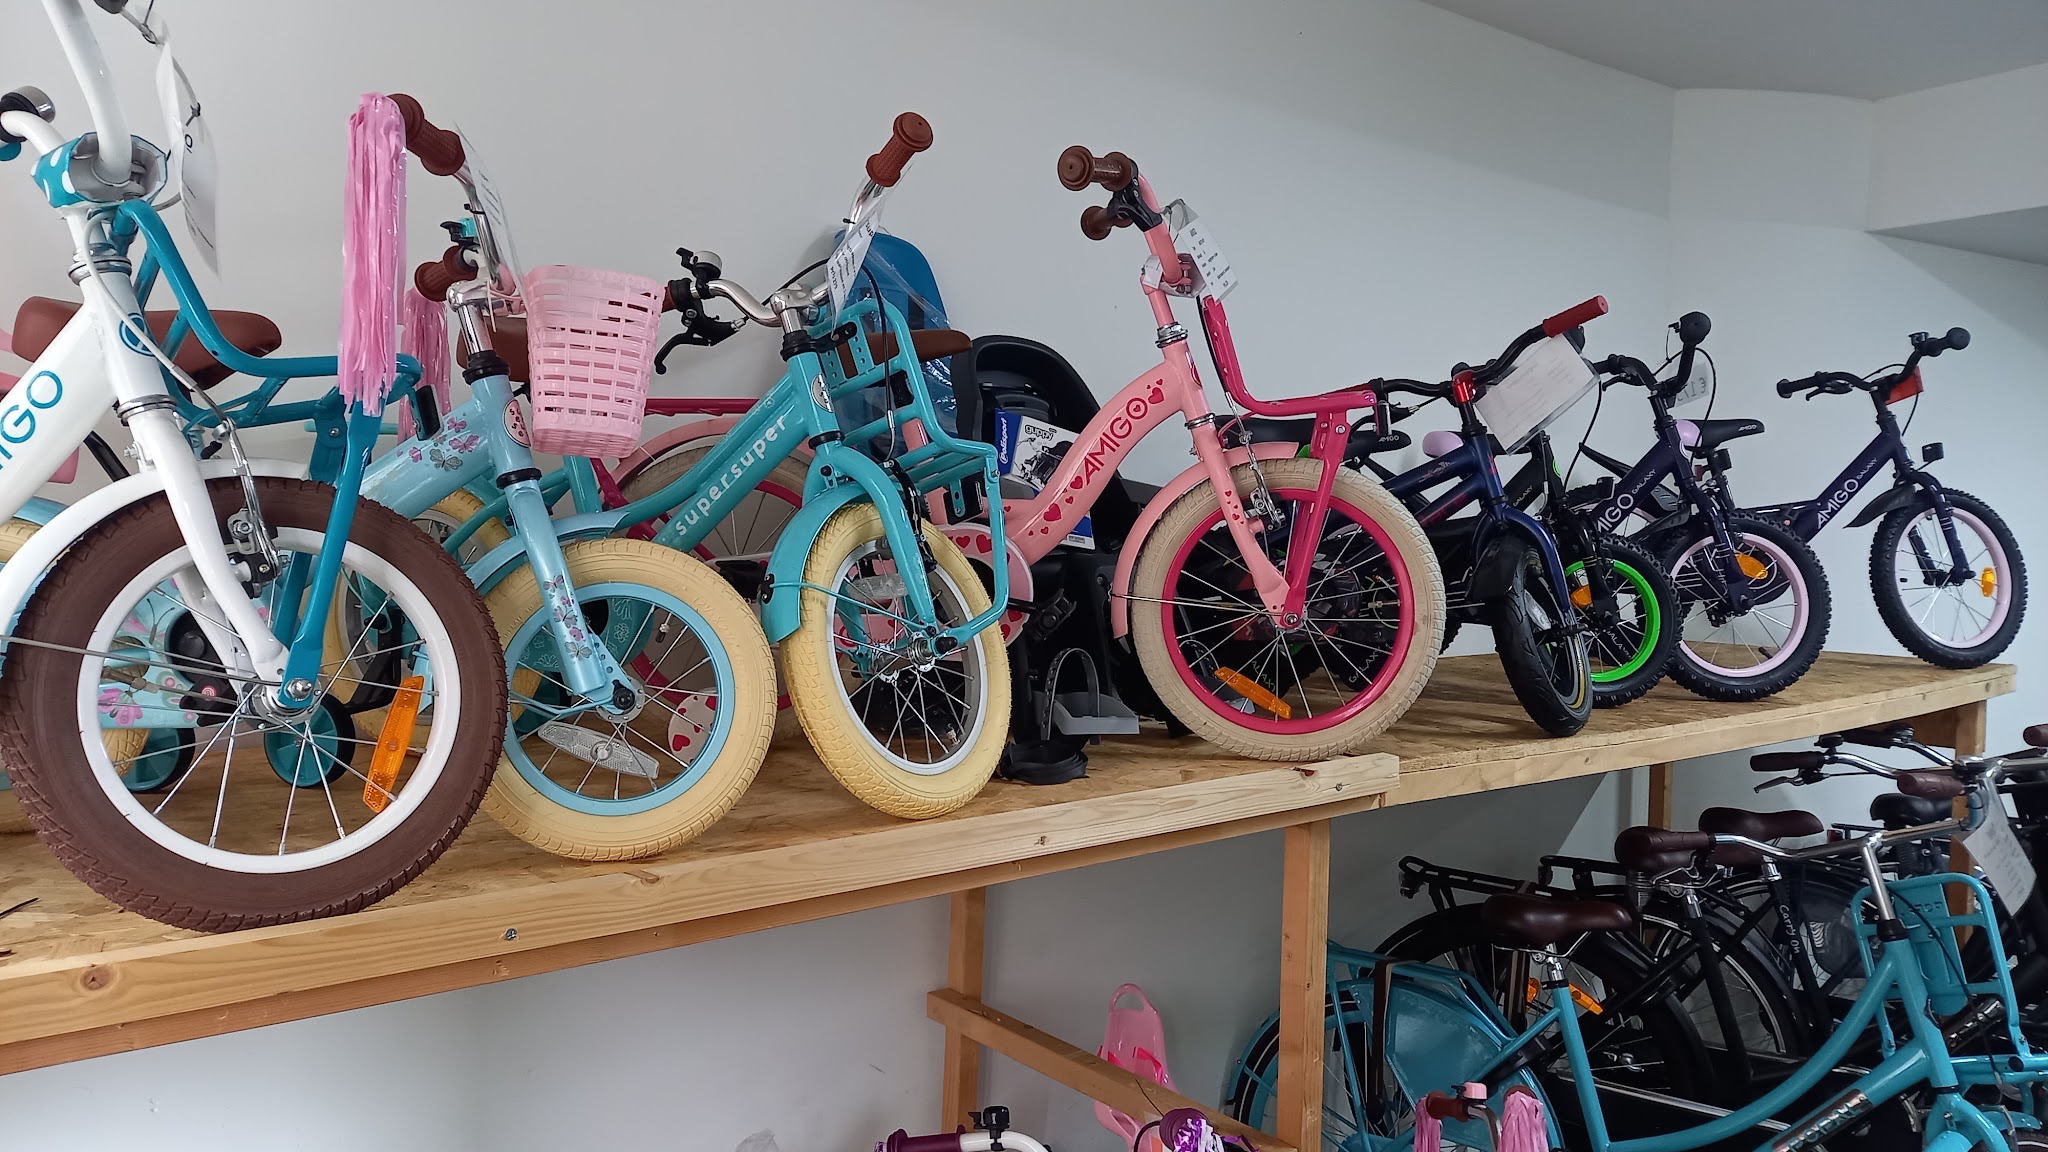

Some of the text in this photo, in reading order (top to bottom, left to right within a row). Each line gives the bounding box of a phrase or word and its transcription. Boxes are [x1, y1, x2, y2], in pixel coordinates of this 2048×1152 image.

[1024, 424, 1054, 441] guppy
[1084, 397, 1149, 486] AMIGO
[675, 415, 786, 536] supersuper
[1597, 468, 1656, 533] MIGO GALAXY
[1817, 478, 1860, 530] AMIGO
[1779, 904, 1797, 936] Carry
